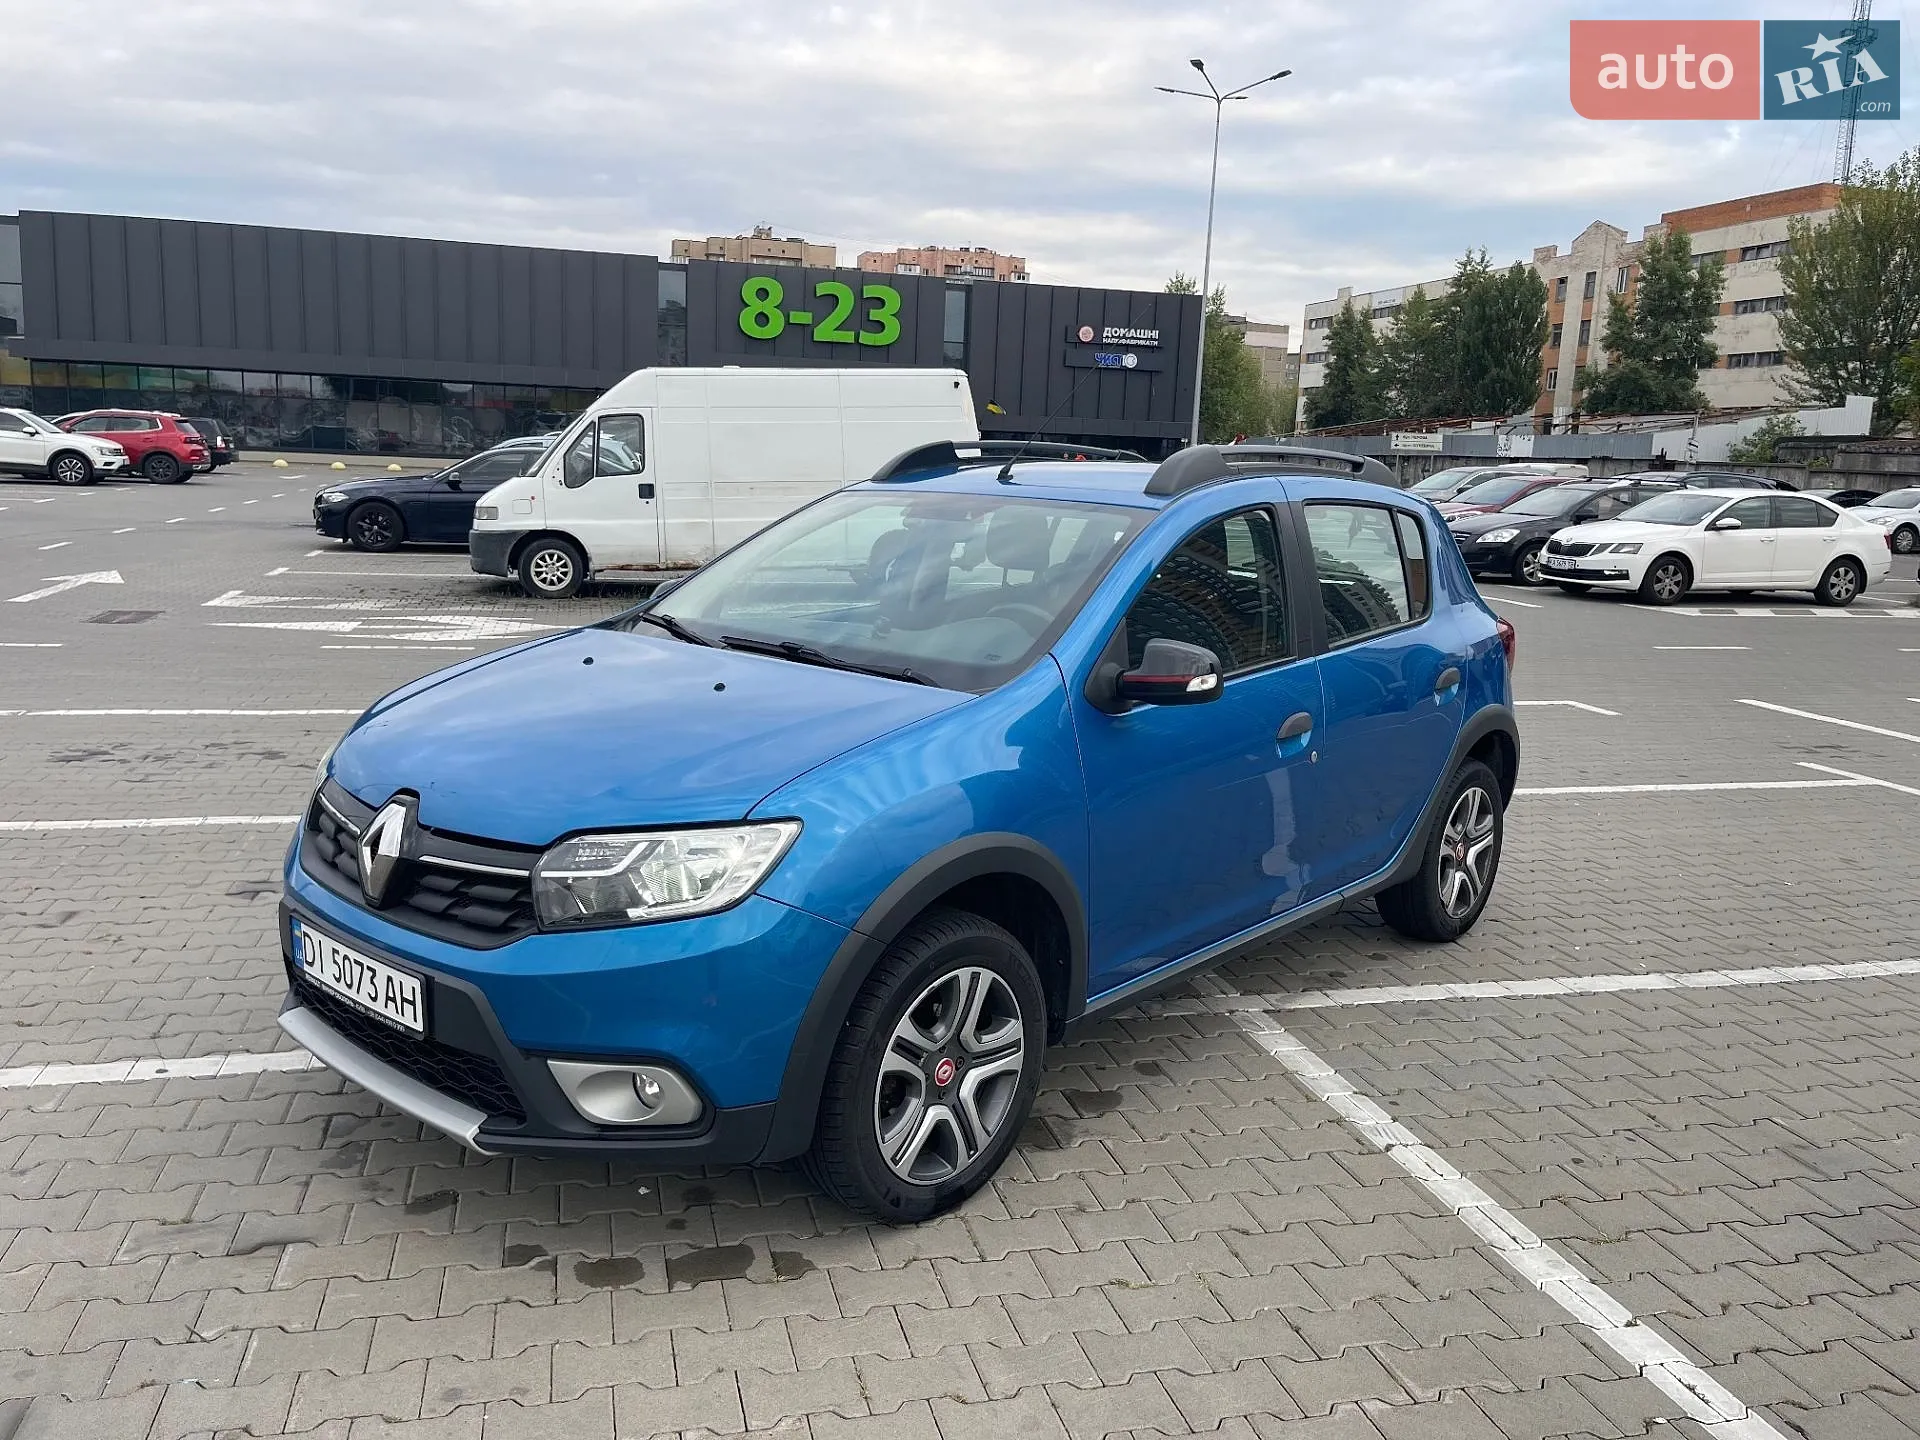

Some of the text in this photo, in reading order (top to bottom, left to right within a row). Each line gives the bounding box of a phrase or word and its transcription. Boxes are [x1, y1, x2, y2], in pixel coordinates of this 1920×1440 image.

[739, 276, 901, 346] 8-23
[1102, 327, 1159, 339] ДОМАШНІ
[295, 948, 304, 961] UA
[303, 930, 324, 974] DI
[332, 947, 379, 1003] 5073
[384, 974, 418, 1023] AH
